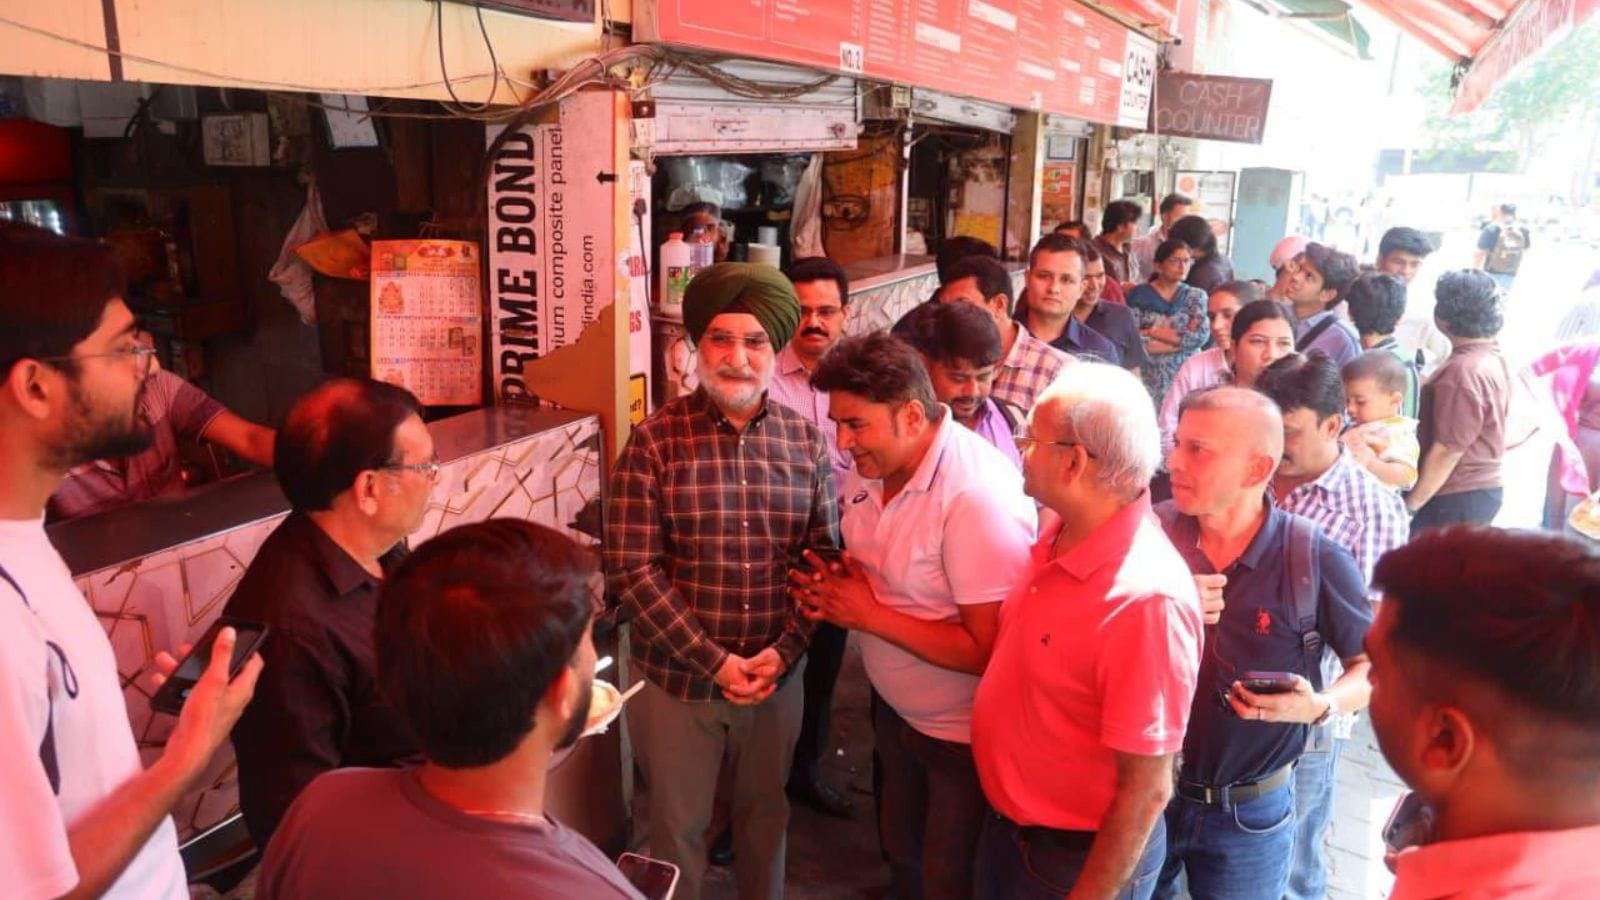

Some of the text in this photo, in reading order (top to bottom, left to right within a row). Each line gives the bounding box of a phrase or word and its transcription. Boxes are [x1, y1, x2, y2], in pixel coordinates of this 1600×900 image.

[1126, 51, 1152, 88] CASH
[1180, 80, 1243, 109] CASH
[1157, 107, 1260, 138] COUNTER
[548, 128, 567, 348] ium composite panel
[495, 132, 540, 406] PRIME BOND
